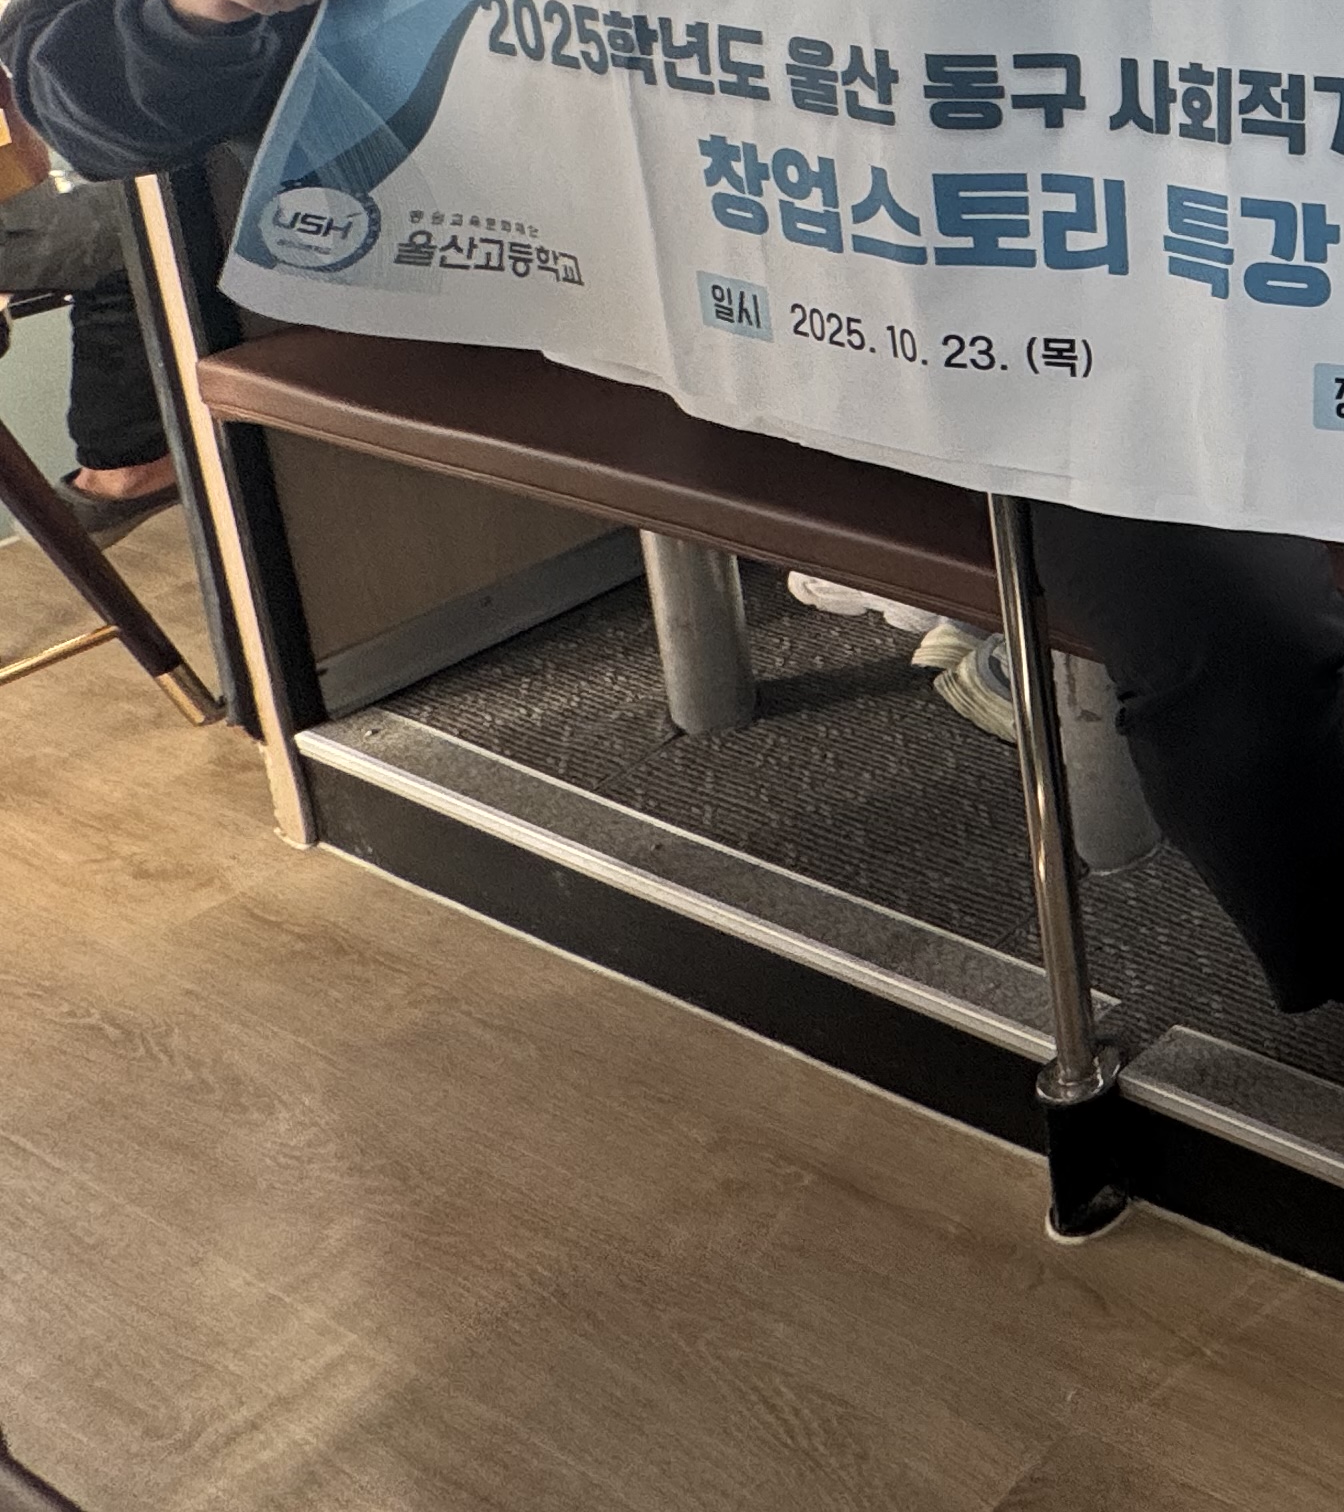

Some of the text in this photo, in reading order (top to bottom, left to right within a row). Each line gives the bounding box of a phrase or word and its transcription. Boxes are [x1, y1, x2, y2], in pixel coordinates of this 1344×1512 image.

[786, 35, 900, 126] 울산
[922, 52, 1087, 130] 동구
[271, 206, 355, 240] USH
[393, 229, 585, 286] 울산고등학교
[697, 133, 1130, 277] 창업스토리
[1163, 183, 1341, 308] 특강
[710, 283, 1094, 378] 일시 2025. 10. 23. (목)
